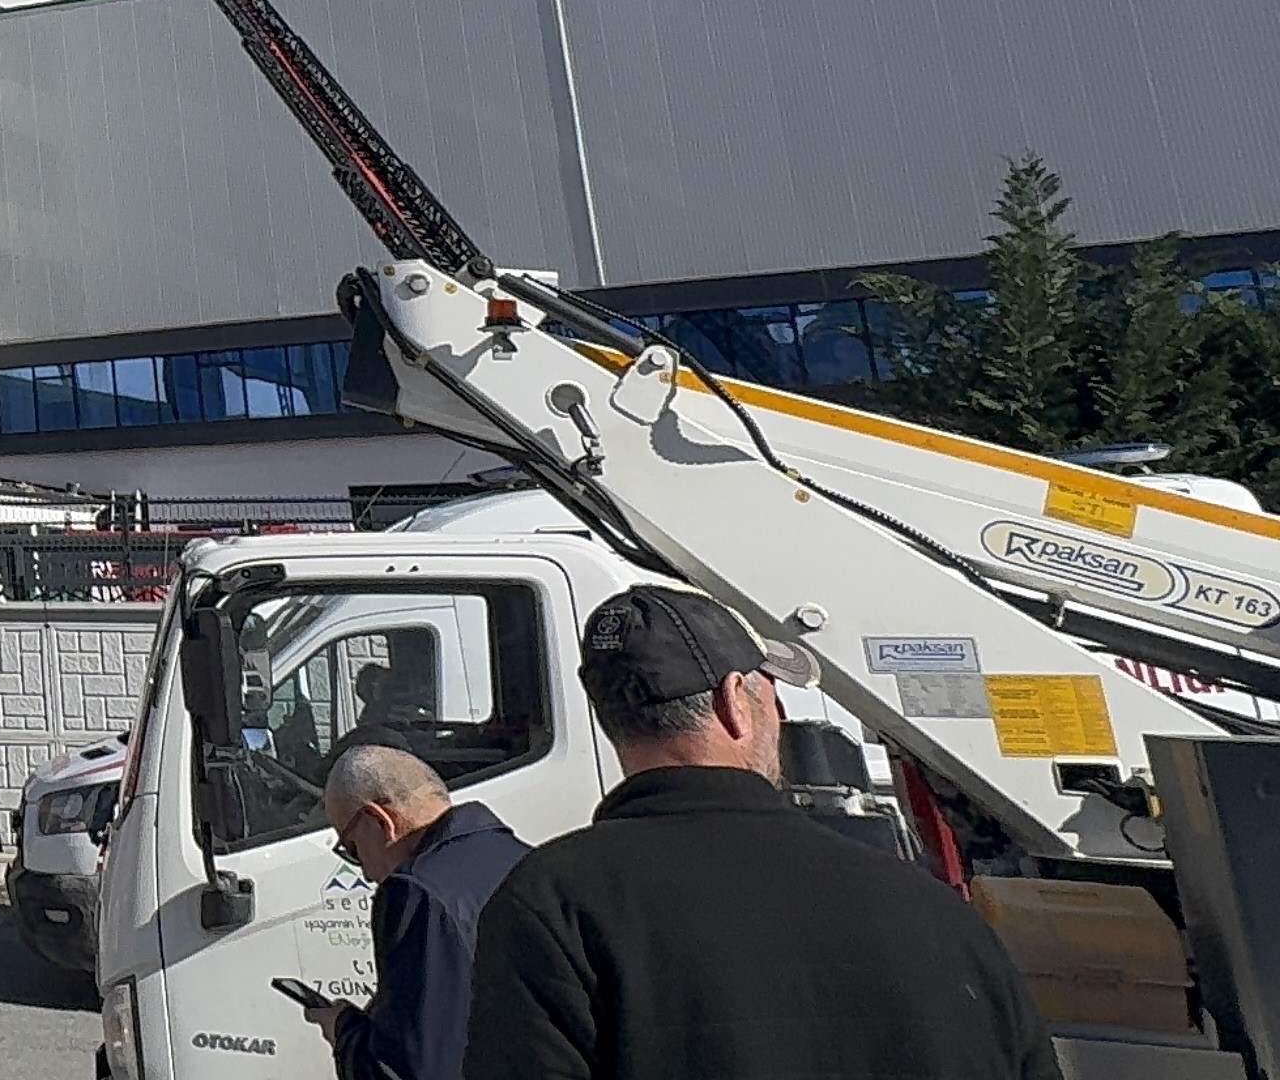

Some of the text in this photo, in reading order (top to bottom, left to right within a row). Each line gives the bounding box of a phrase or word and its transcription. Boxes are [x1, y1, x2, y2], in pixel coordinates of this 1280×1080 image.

[1194, 584, 1228, 606] KT
[1234, 595, 1273, 619] 163
[325, 895, 369, 911] sed
[328, 977, 368, 996] GÜN
[191, 1032, 277, 1056] OTOKAR
